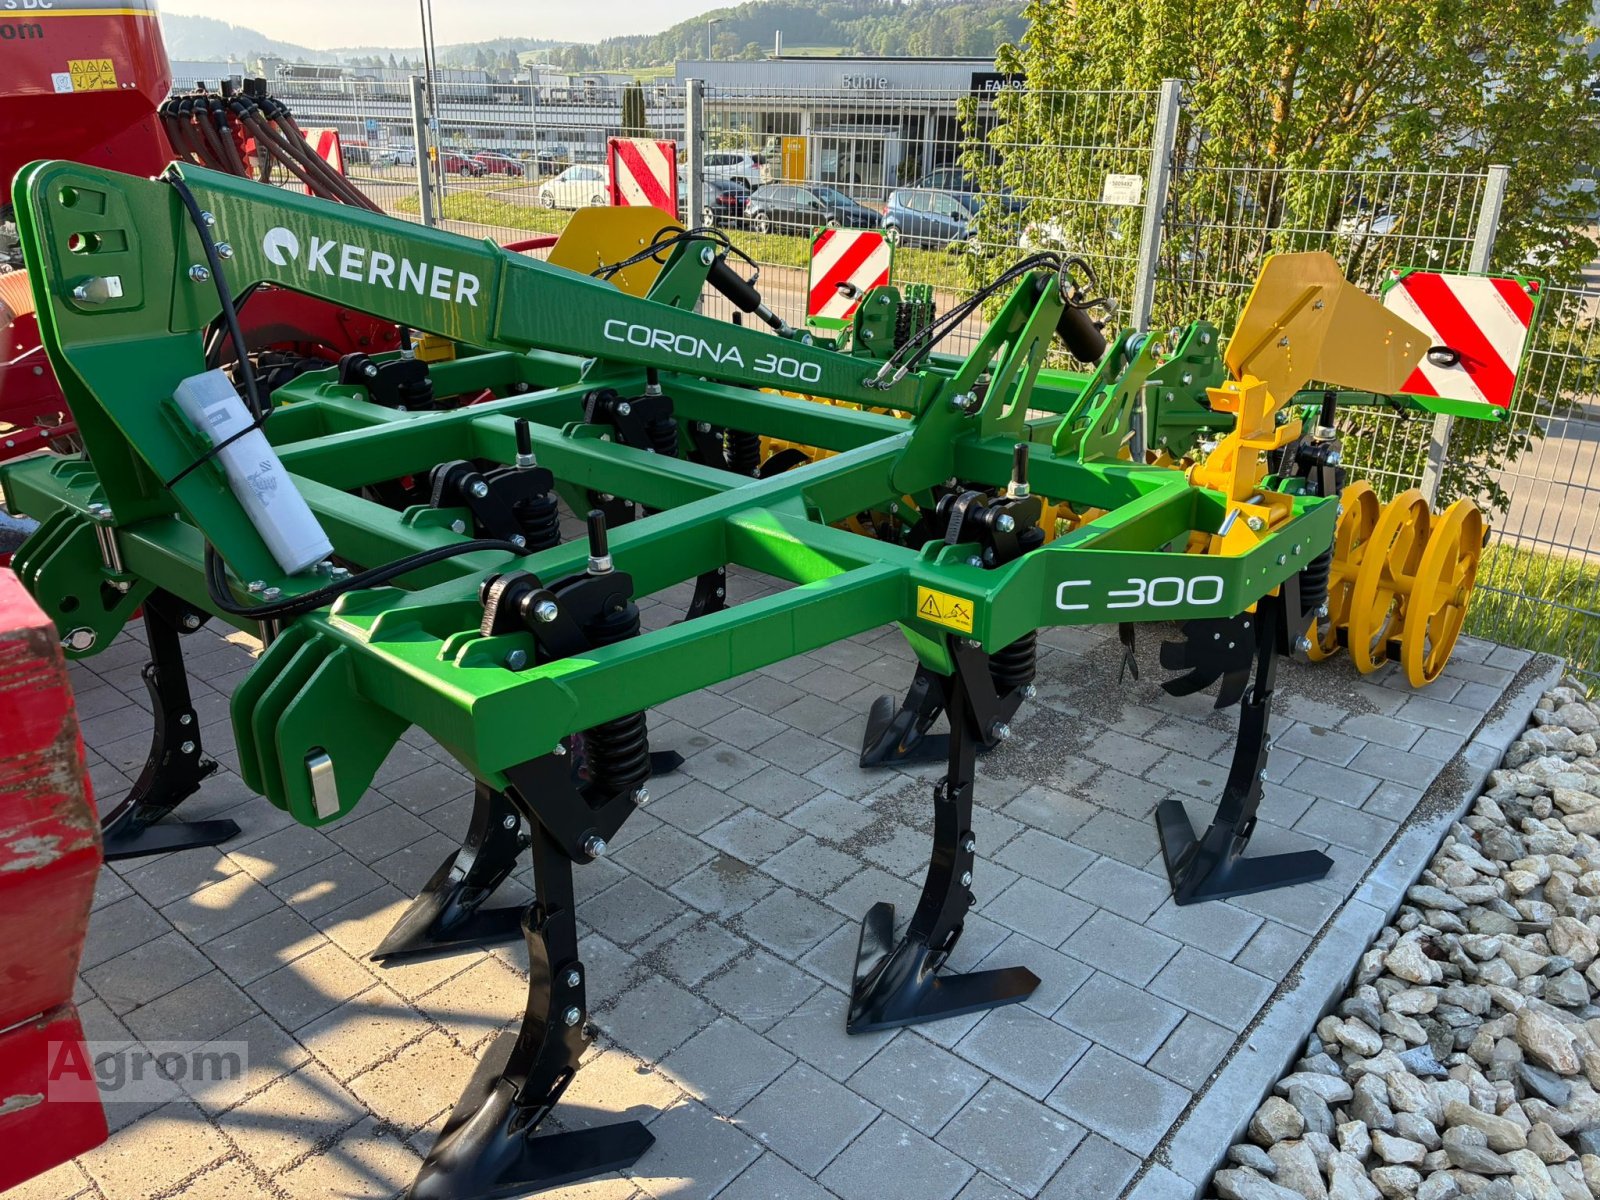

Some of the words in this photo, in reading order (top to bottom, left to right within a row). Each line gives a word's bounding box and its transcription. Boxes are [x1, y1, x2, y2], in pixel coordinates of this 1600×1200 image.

[841, 73, 888, 89] Bühle
[308, 236, 480, 307] KERNER
[603, 319, 745, 369] CORONA
[753, 353, 822, 383] 300
[1056, 580, 1092, 610] C
[1106, 575, 1224, 609] 300
